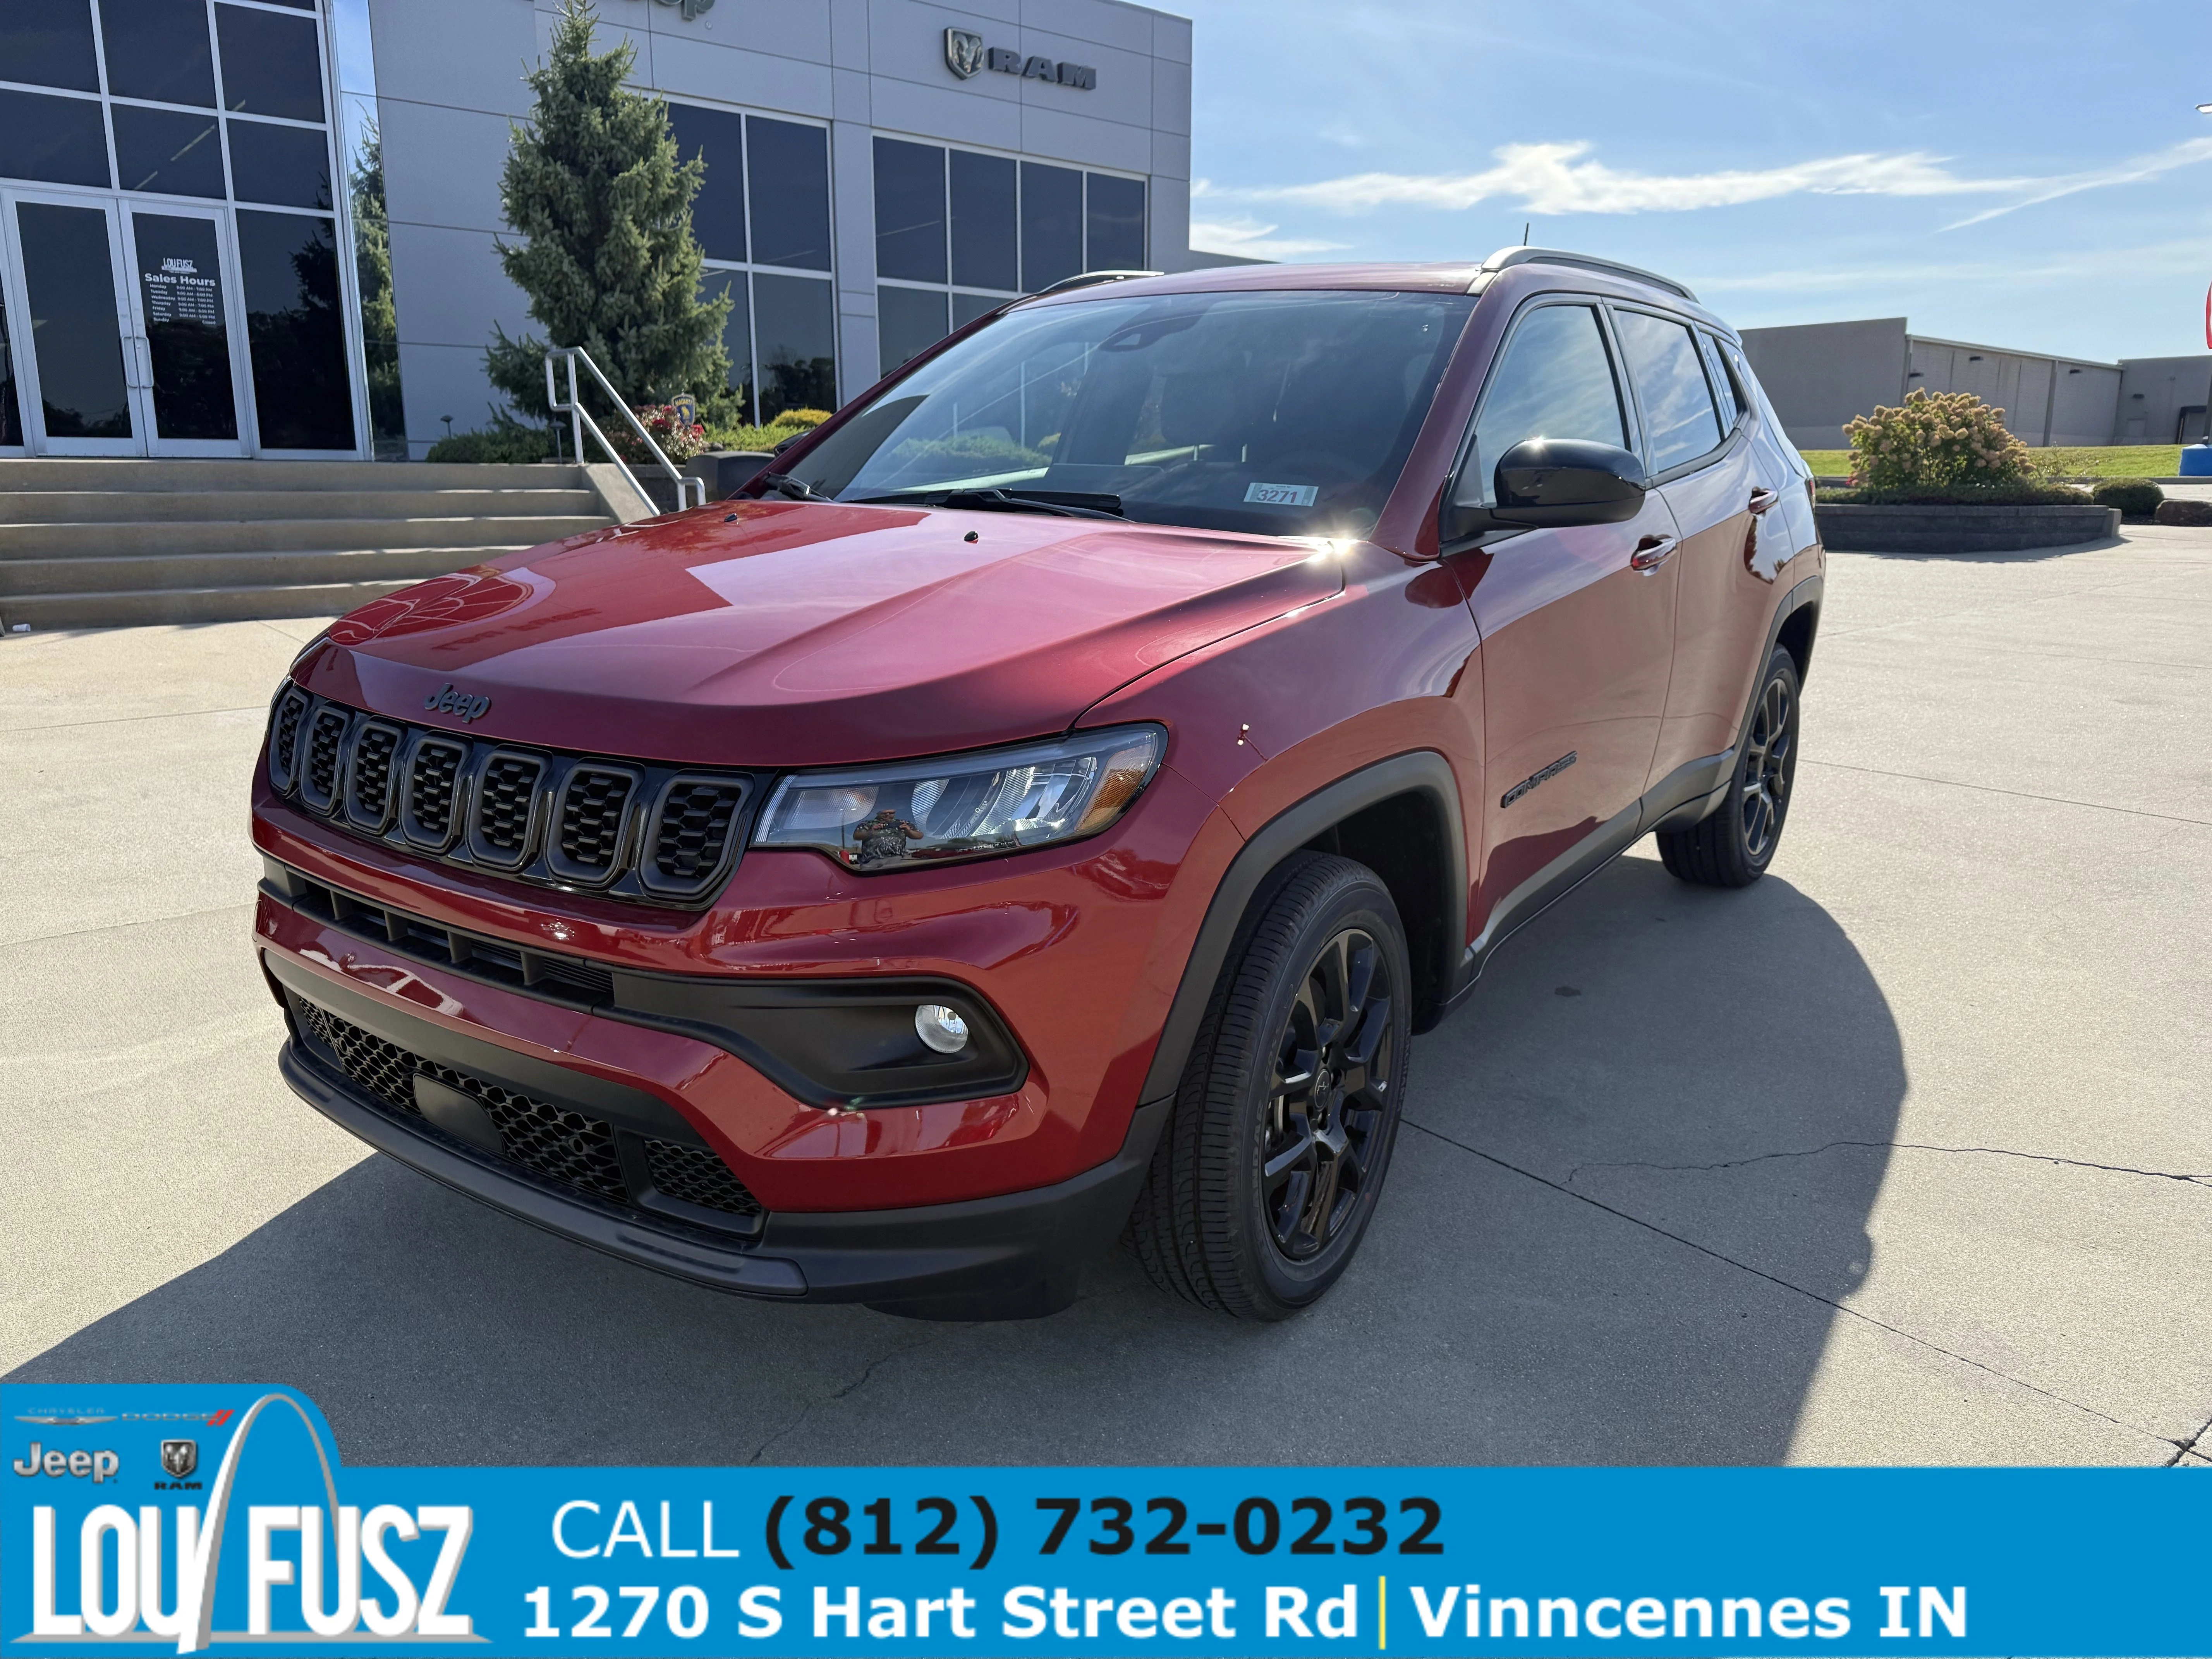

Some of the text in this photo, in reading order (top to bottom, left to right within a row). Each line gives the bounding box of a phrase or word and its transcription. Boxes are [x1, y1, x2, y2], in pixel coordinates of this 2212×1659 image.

[988, 47, 1096, 90] RAM
[145, 273, 215, 286] Sales Hours
[1257, 489, 1298, 503] 3271
[424, 683, 491, 724] Jeep
[1500, 750, 1577, 808] COMPASS
